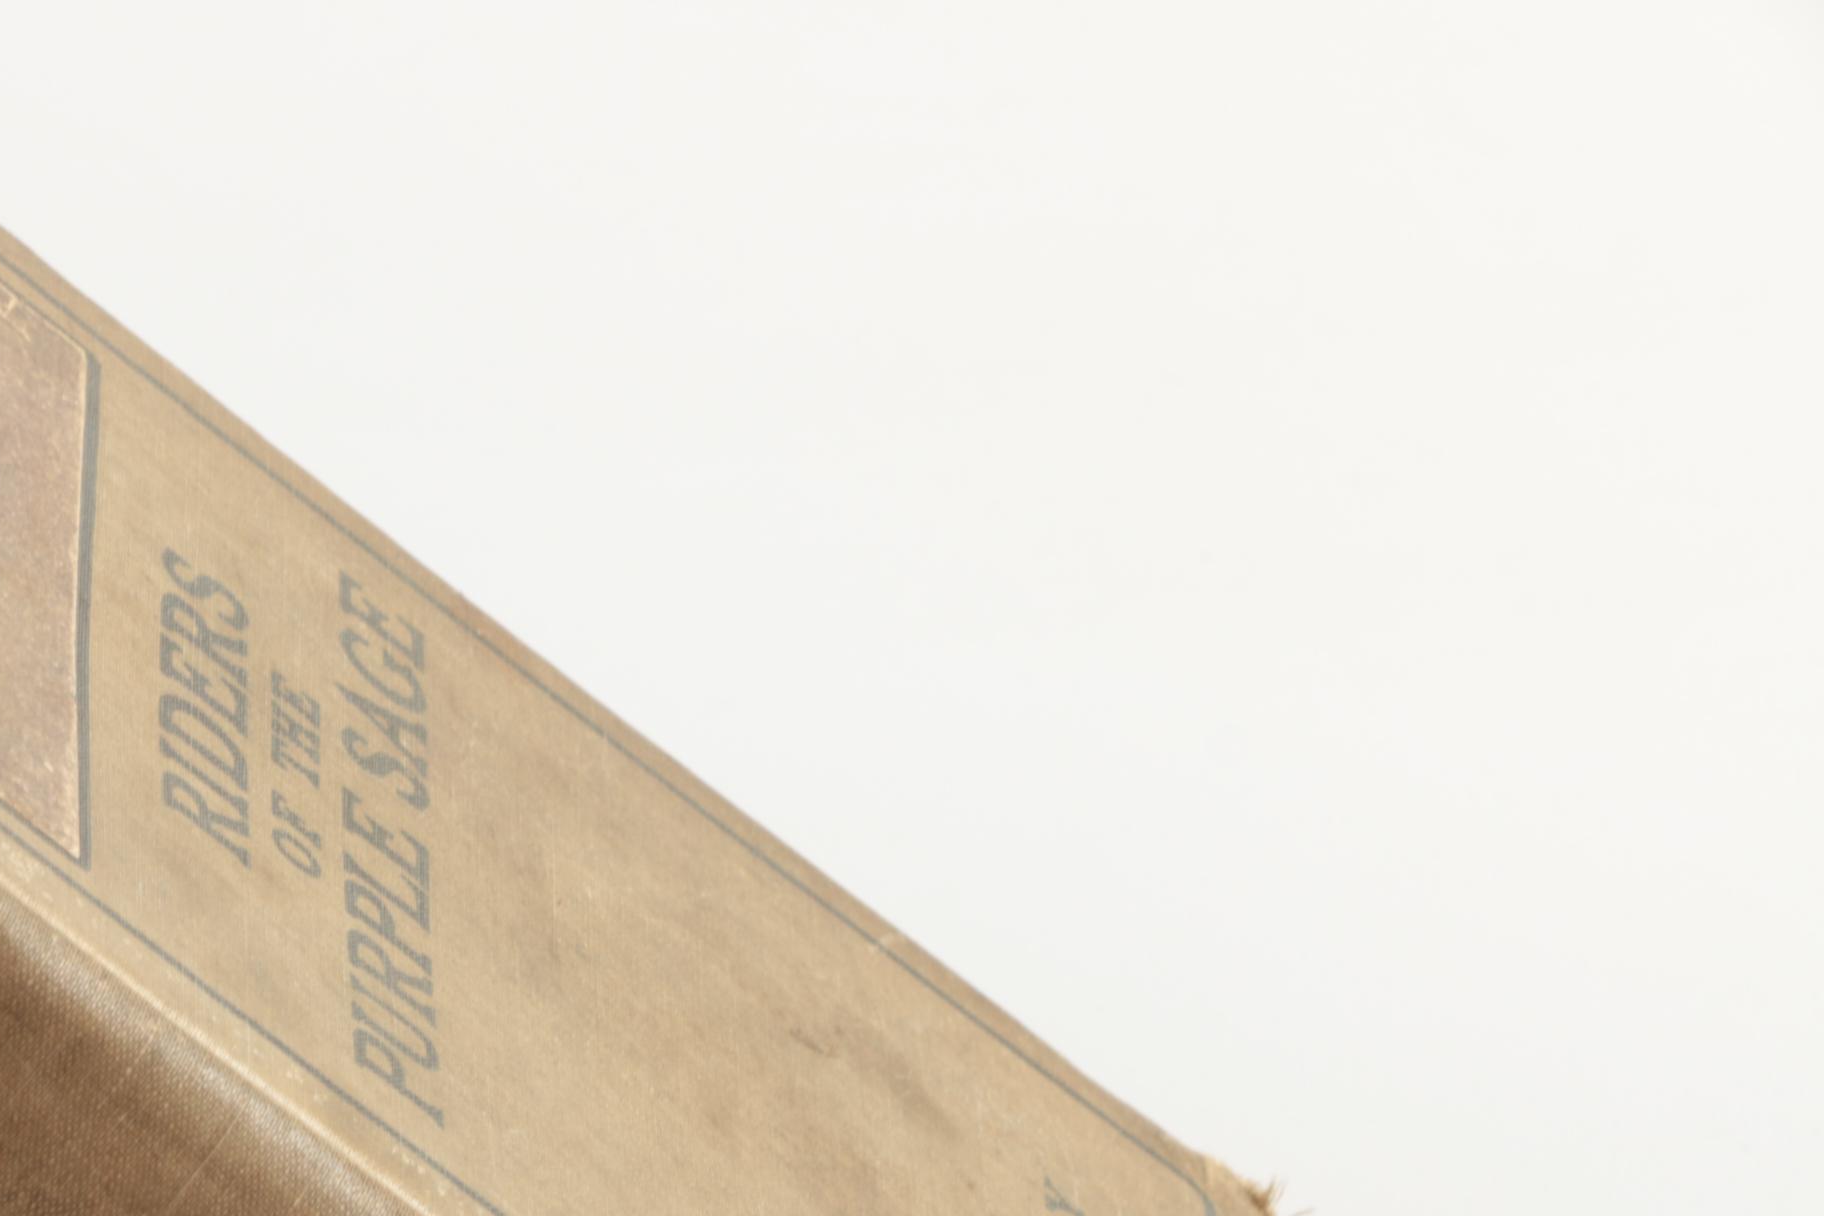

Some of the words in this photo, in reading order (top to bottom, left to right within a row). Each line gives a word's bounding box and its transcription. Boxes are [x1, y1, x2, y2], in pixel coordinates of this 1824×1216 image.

[160, 548, 250, 870] RIDERS
[271, 671, 321, 788] THE
[338, 571, 430, 811] SAGE
[272, 789, 322, 878] OF
[343, 786, 445, 1130] PURPLE
